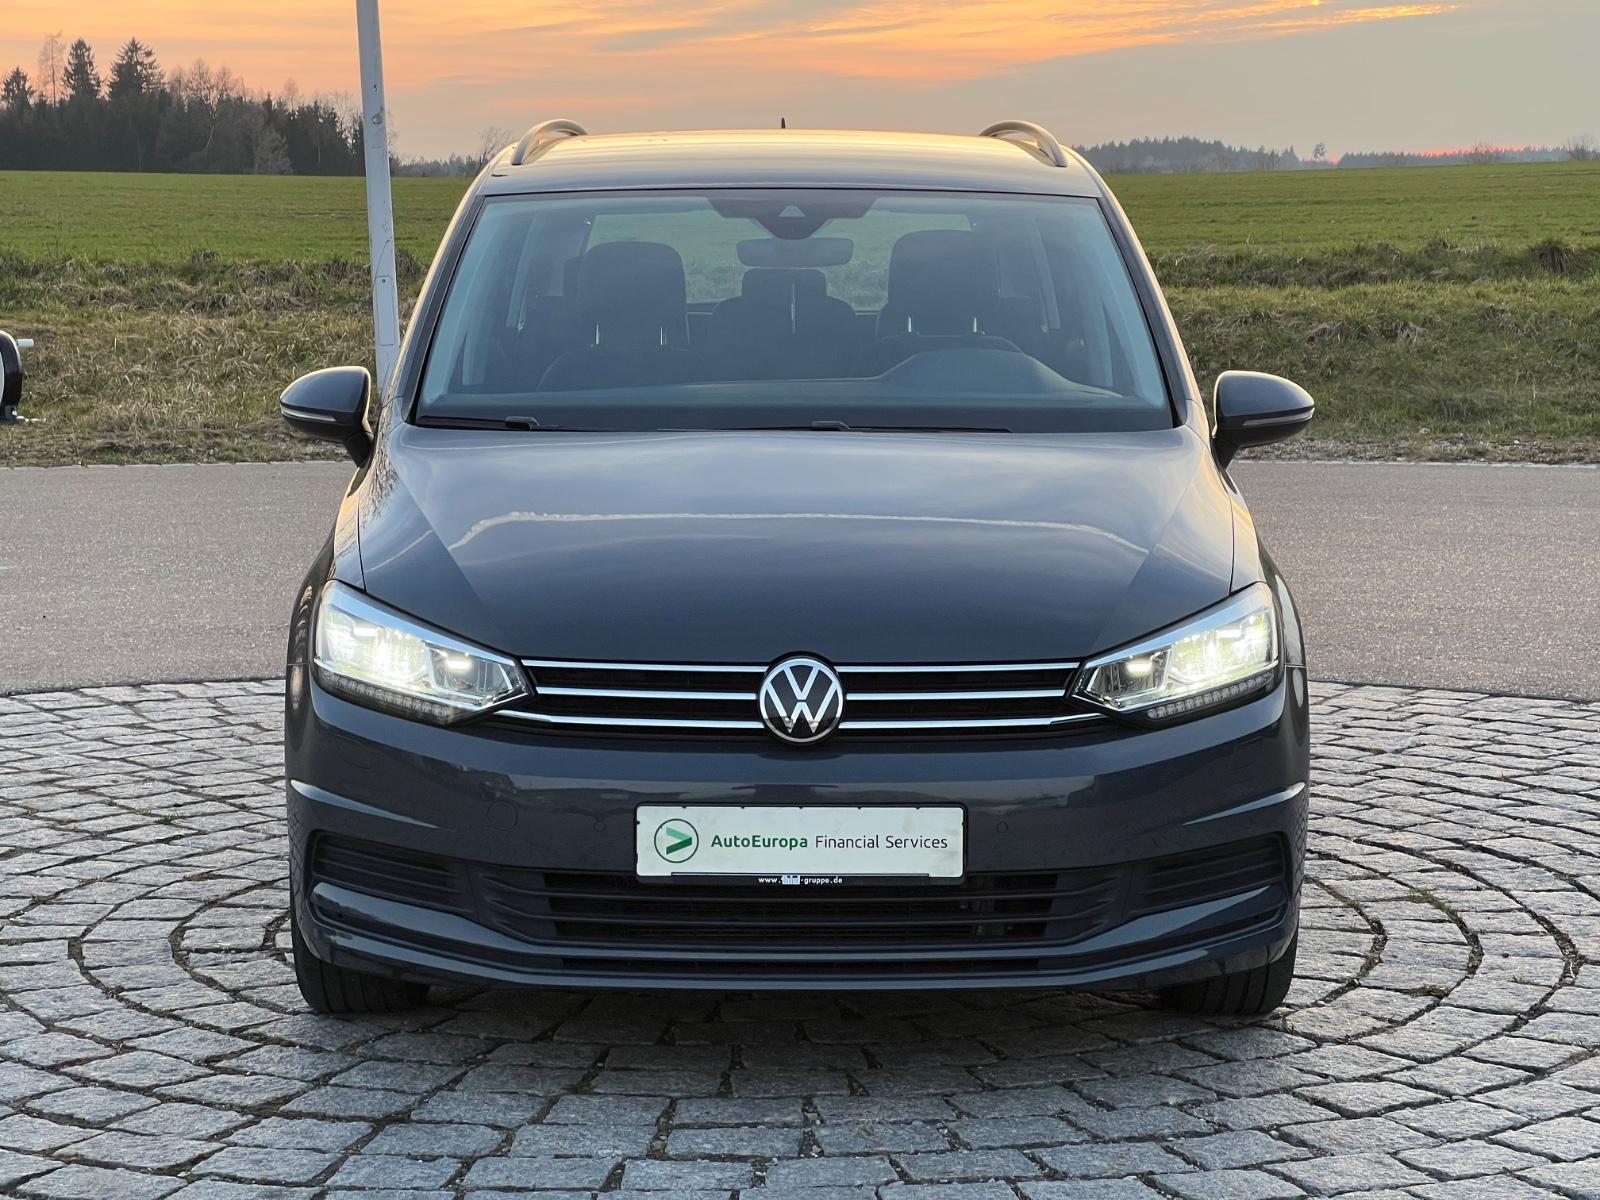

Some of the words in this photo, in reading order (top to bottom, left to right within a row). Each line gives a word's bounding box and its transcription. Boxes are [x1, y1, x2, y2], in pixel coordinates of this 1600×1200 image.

[761, 661, 841, 738] VW
[711, 835, 808, 850] AutoEuropa
[815, 835, 879, 849] Financial
[885, 835, 948, 849] Services
